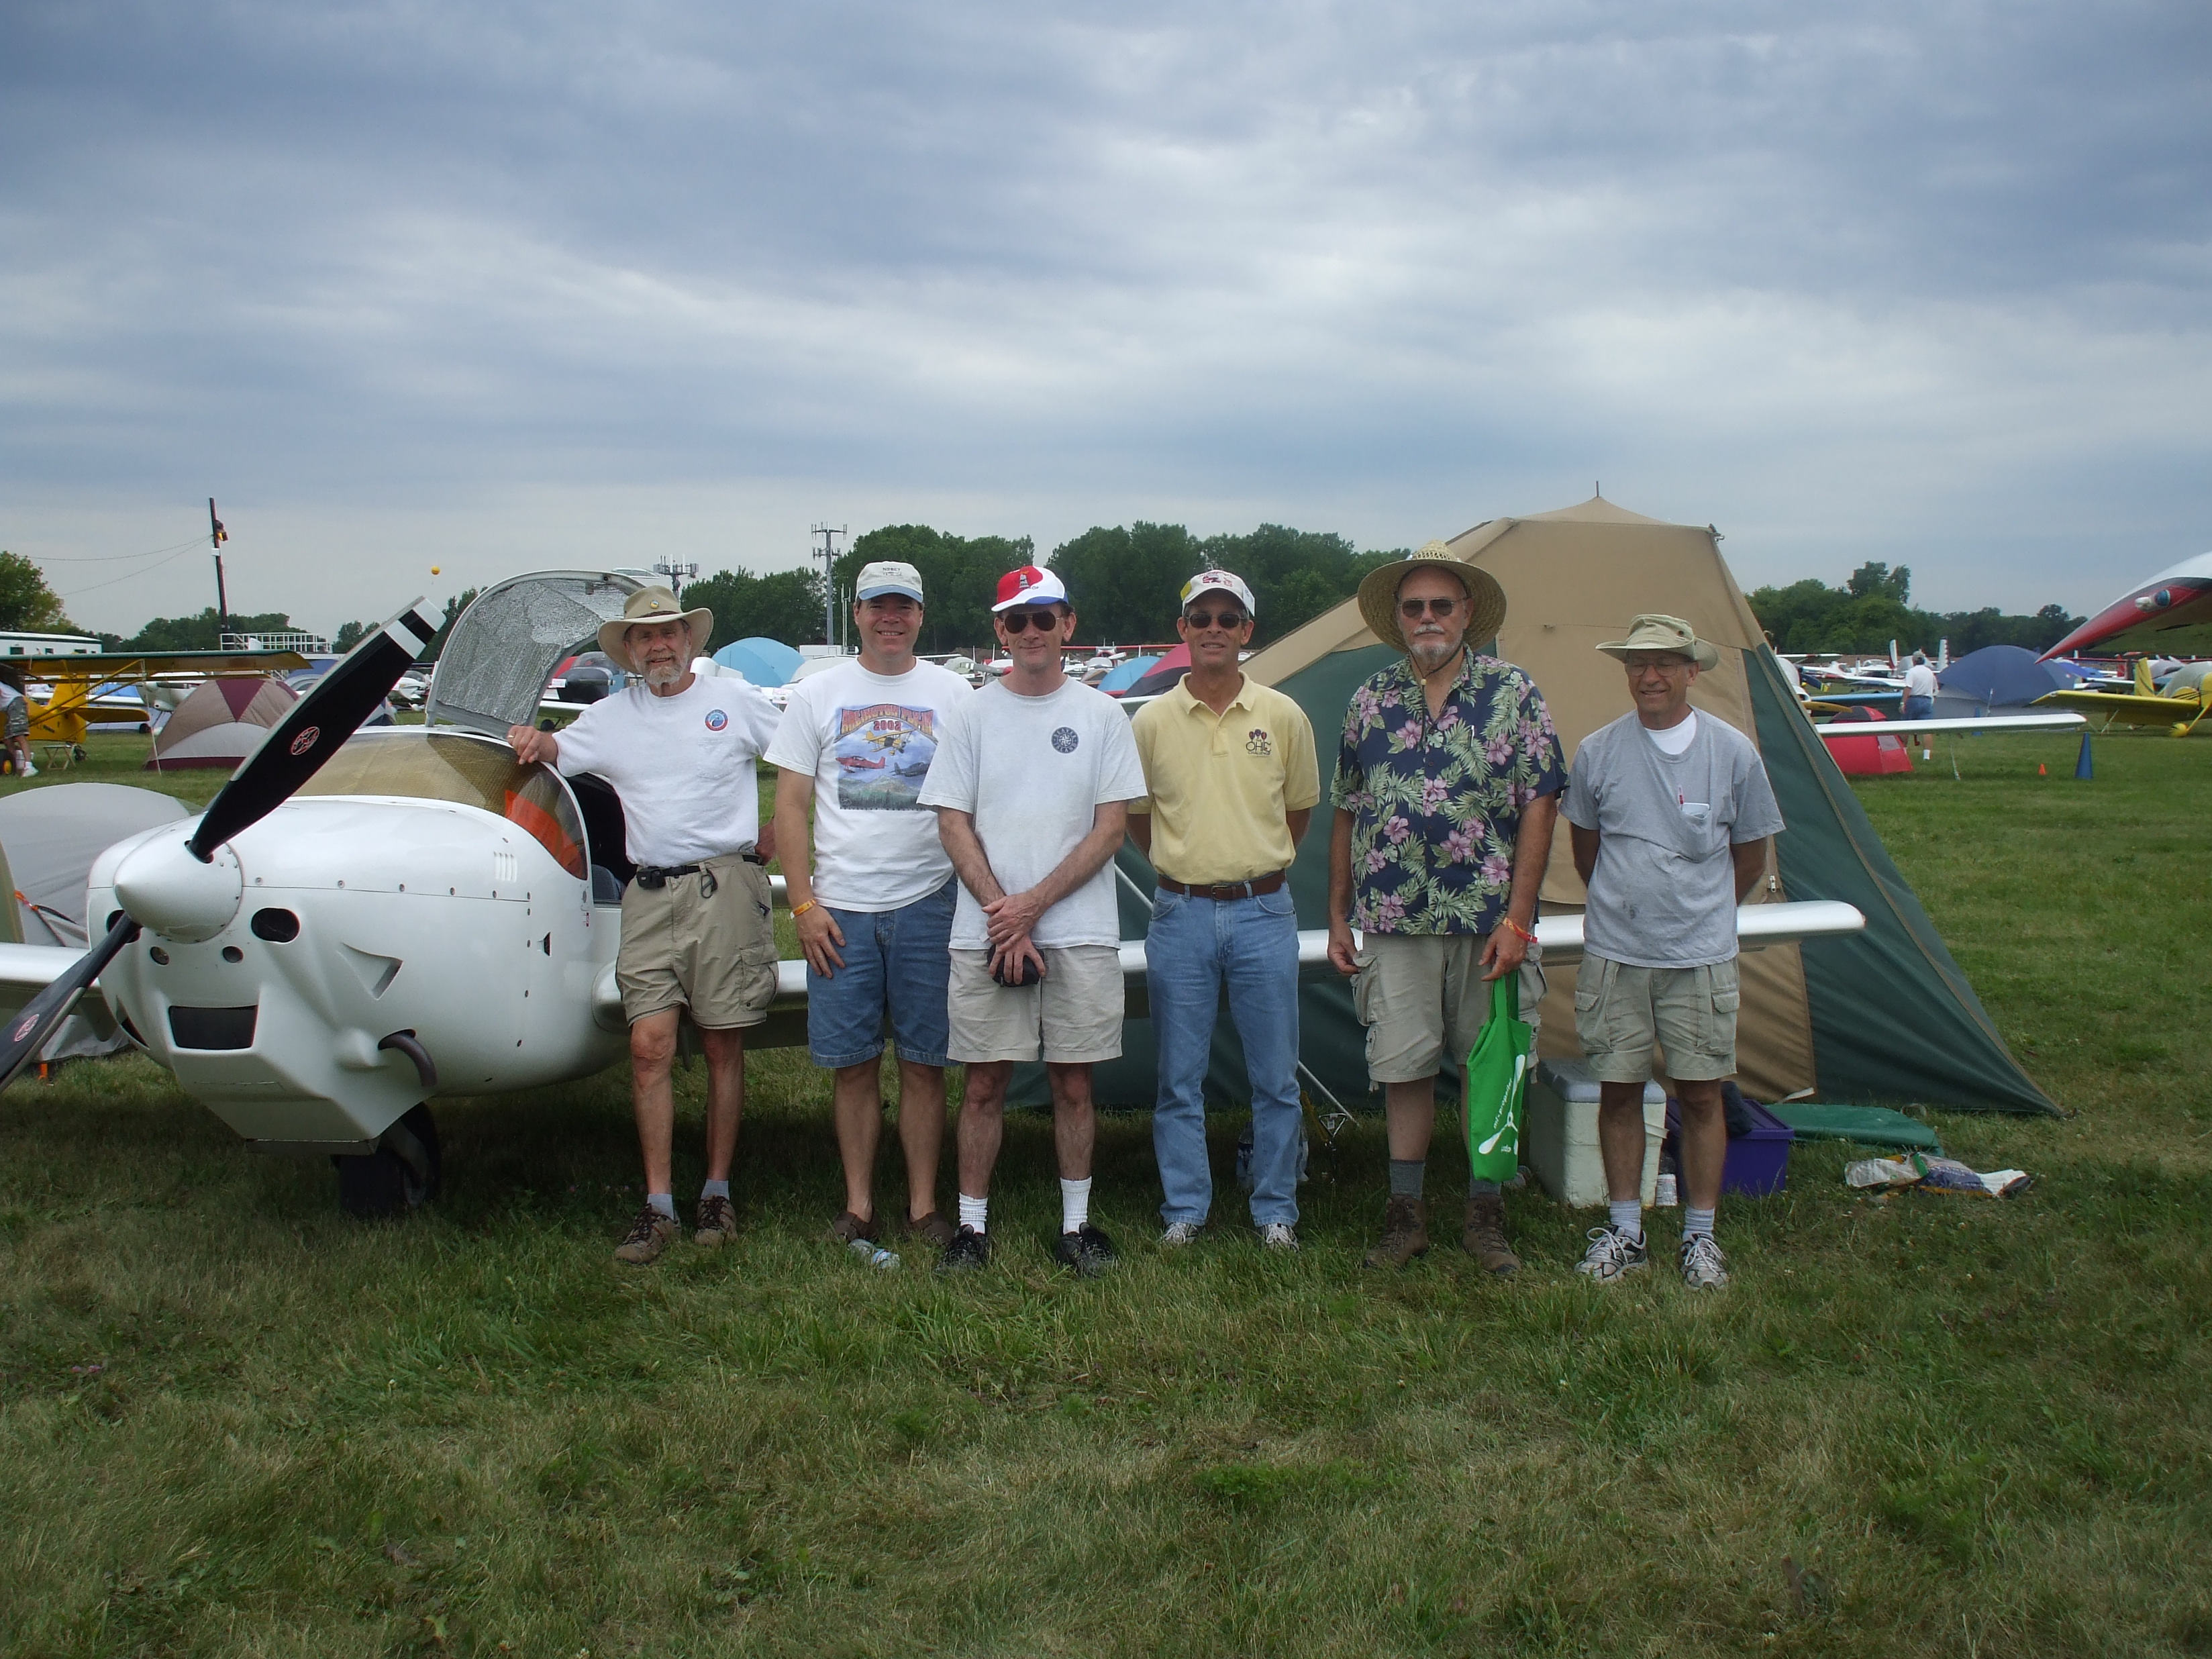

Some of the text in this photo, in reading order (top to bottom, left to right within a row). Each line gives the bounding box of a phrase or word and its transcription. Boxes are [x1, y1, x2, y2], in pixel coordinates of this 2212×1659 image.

[874, 720, 901, 731] 2002
[1054, 727, 1076, 738] BEAVER
[1053, 743, 1076, 752] ISLAND
